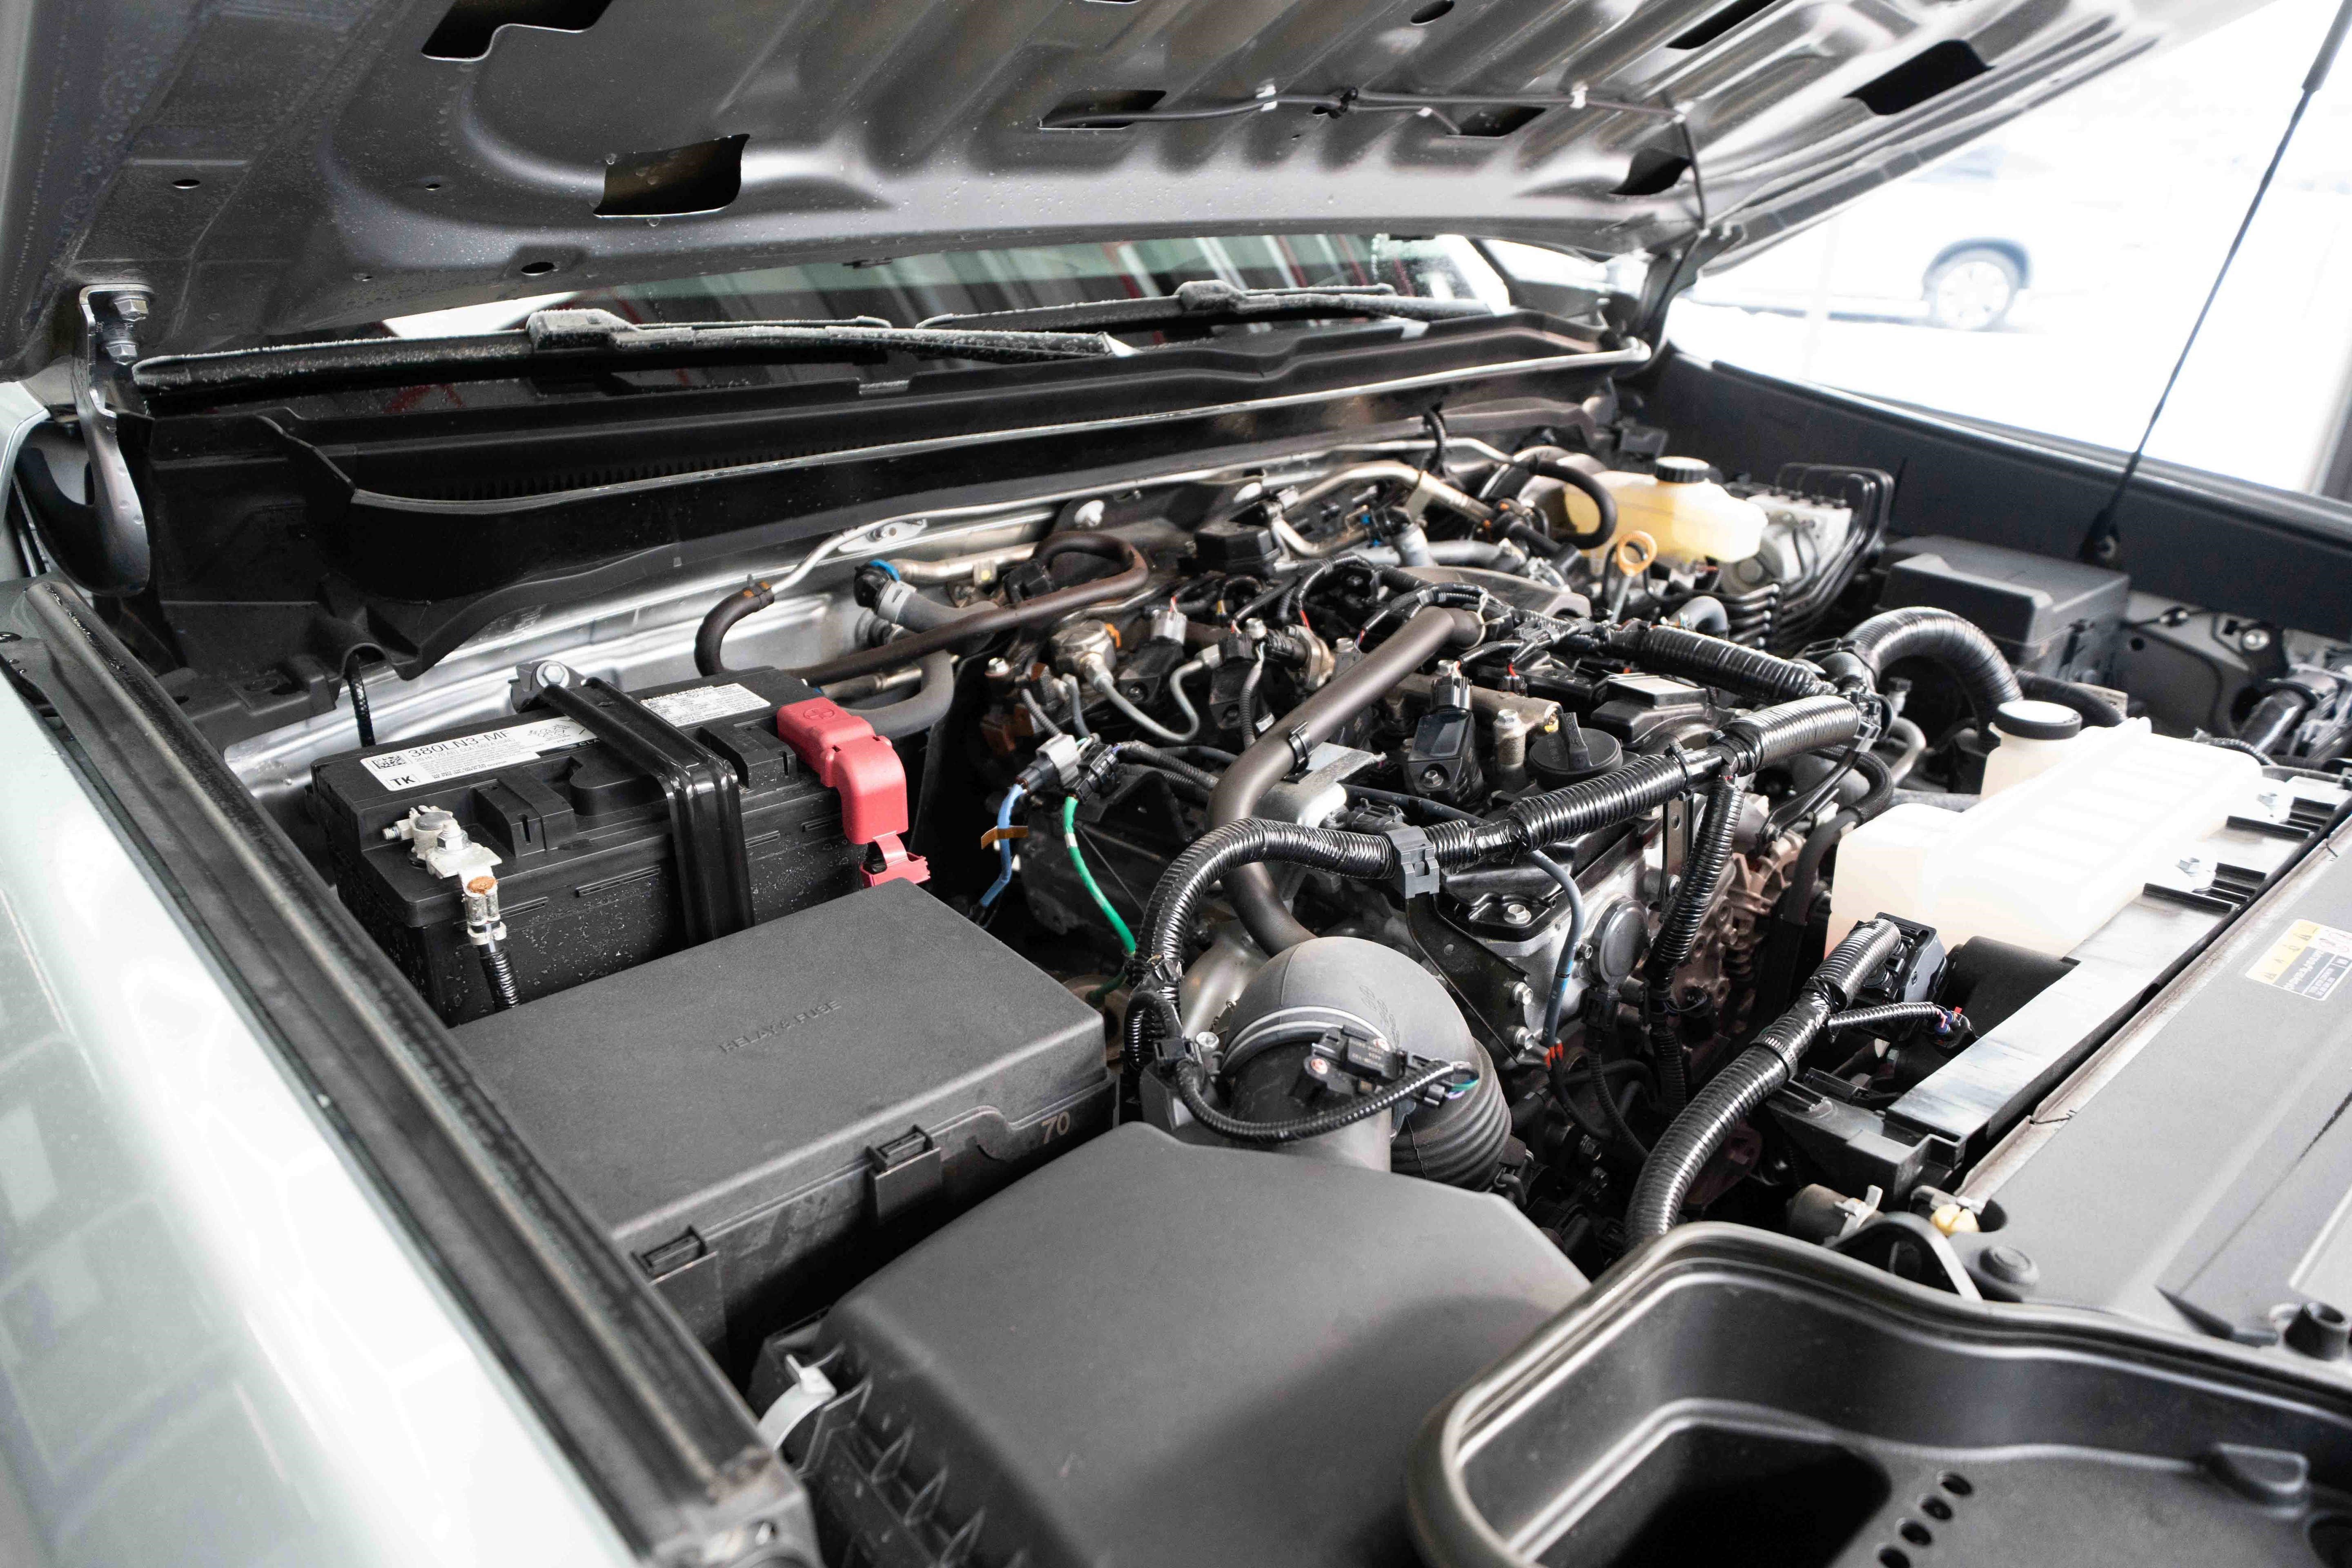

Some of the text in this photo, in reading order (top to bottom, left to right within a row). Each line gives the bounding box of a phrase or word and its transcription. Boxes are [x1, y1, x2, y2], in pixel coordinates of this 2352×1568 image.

[408, 730, 510, 757] 380LN3-MF
[390, 775, 416, 786] TK
[718, 1020, 777, 1054] RELAY
[794, 1000, 842, 1024] FUSE
[1041, 1111, 1070, 1144] 70
